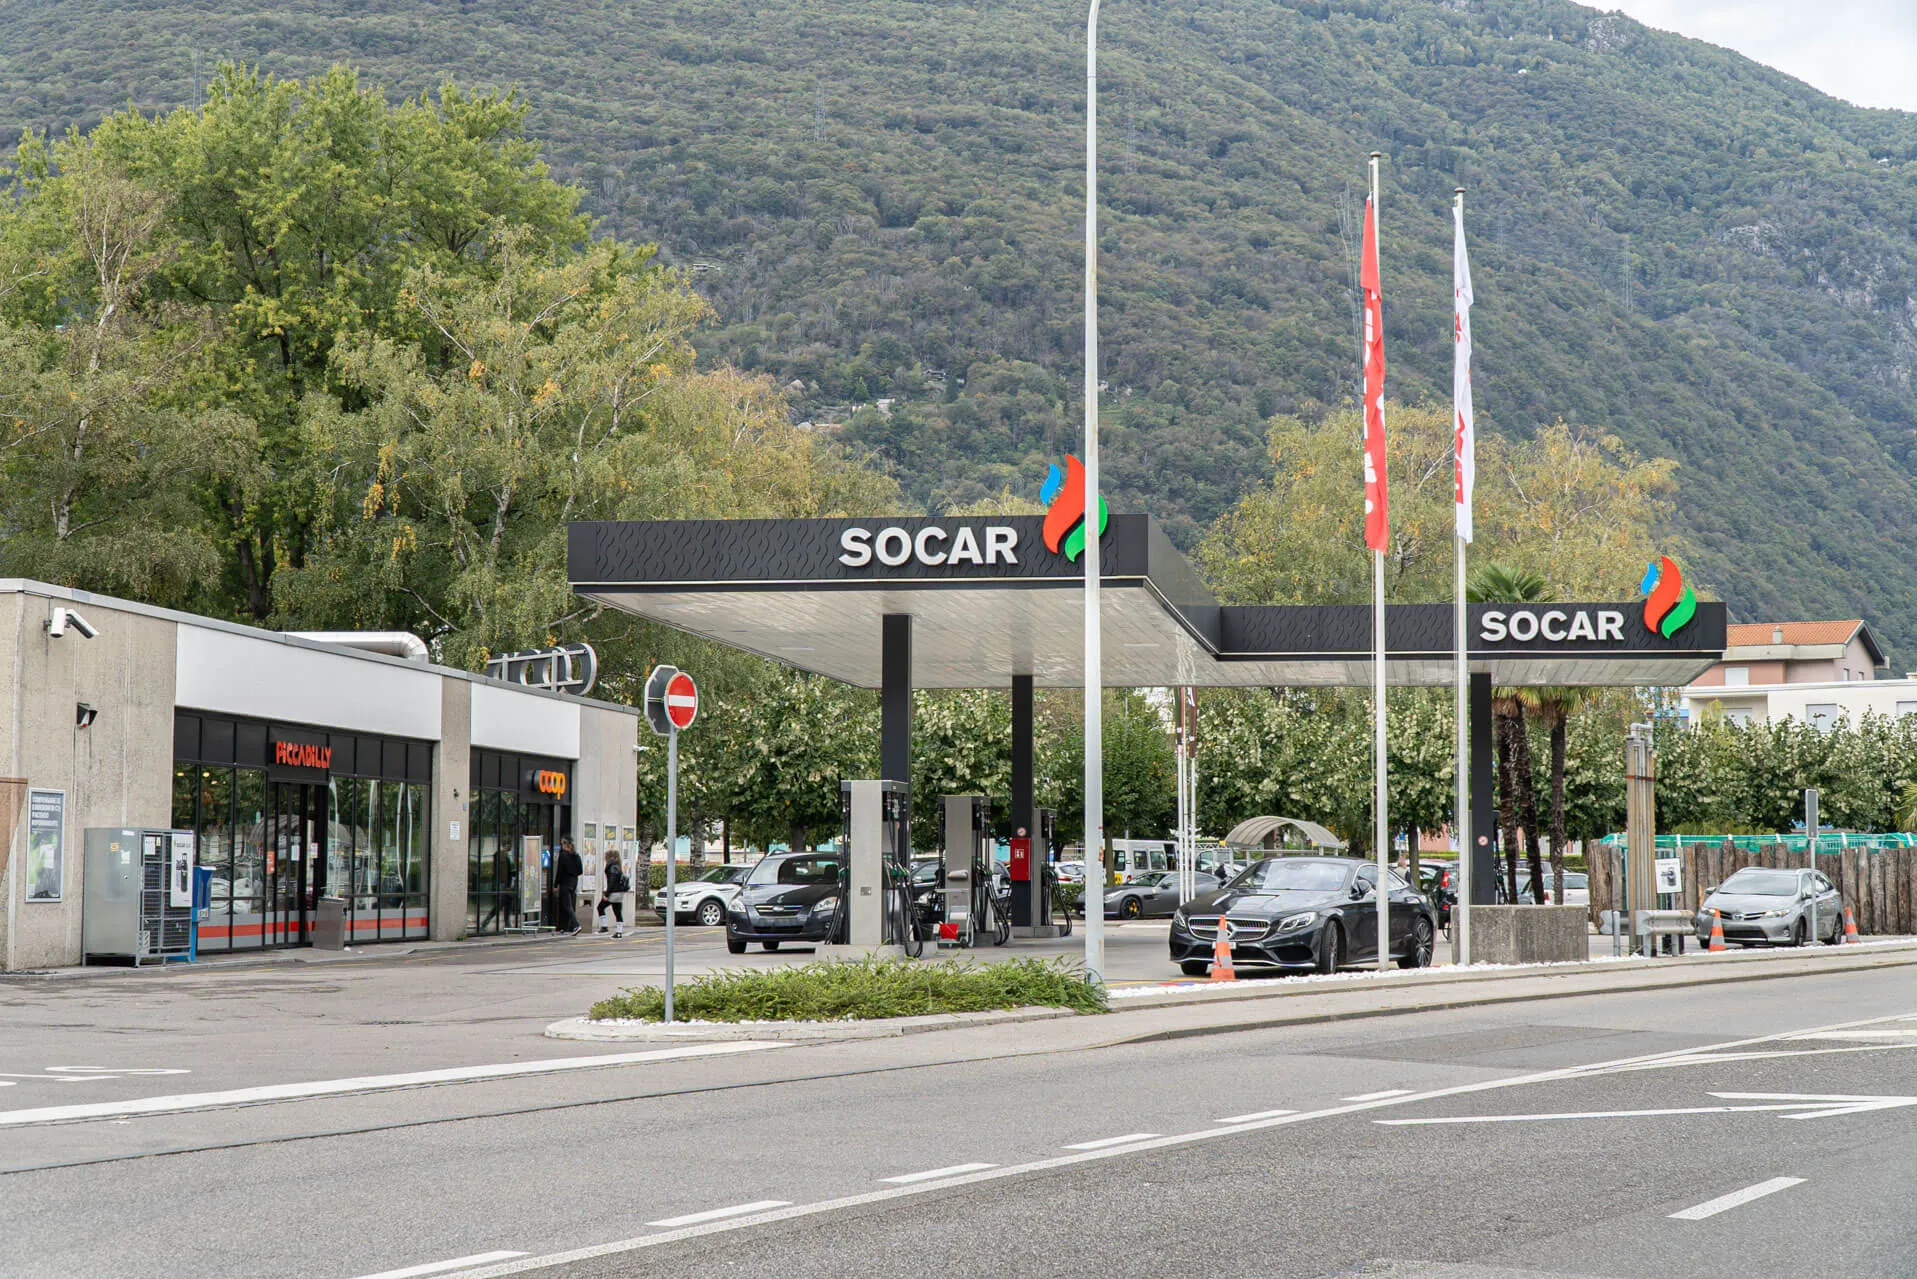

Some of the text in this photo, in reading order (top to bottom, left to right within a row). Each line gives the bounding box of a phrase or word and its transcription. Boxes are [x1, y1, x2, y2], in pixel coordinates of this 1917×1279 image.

[838, 526, 1019, 567] SOCAR
[1480, 610, 1625, 642] SOCAR
[539, 770, 566, 800] coop
